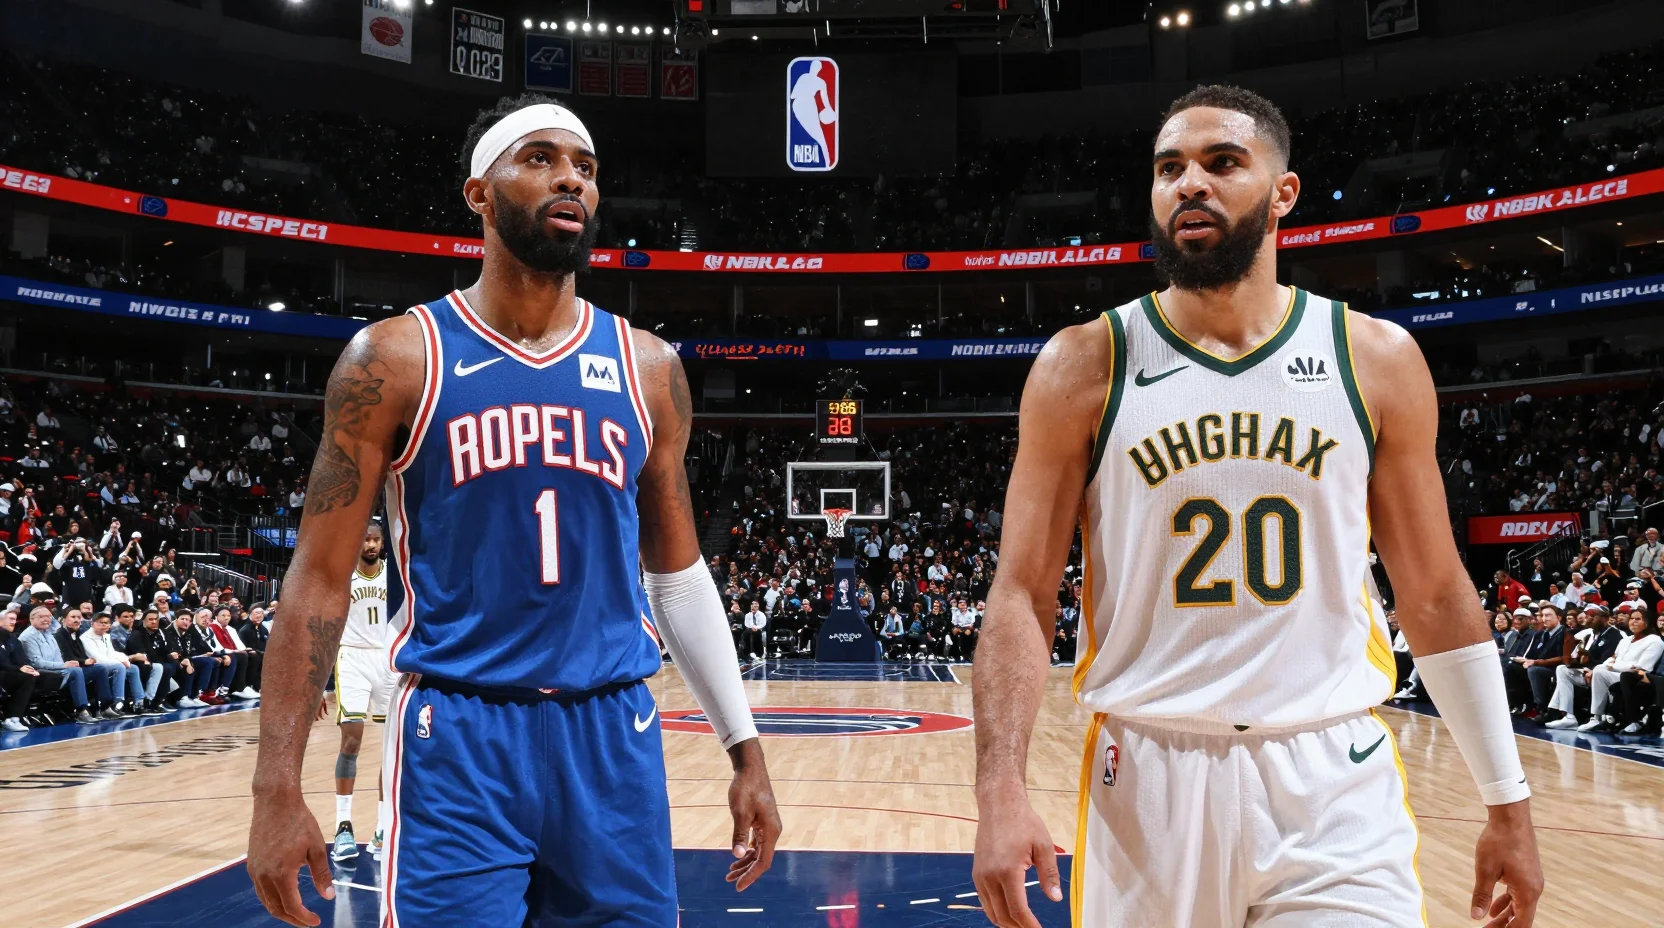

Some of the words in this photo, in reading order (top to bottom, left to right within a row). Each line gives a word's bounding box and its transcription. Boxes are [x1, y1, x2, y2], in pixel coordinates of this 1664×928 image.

[794, 144, 820, 164] NBA
[446, 403, 629, 490] ROPELS
[534, 488, 561, 586] 1
[1170, 494, 1304, 608] 20
[367, 606, 379, 625] 11
